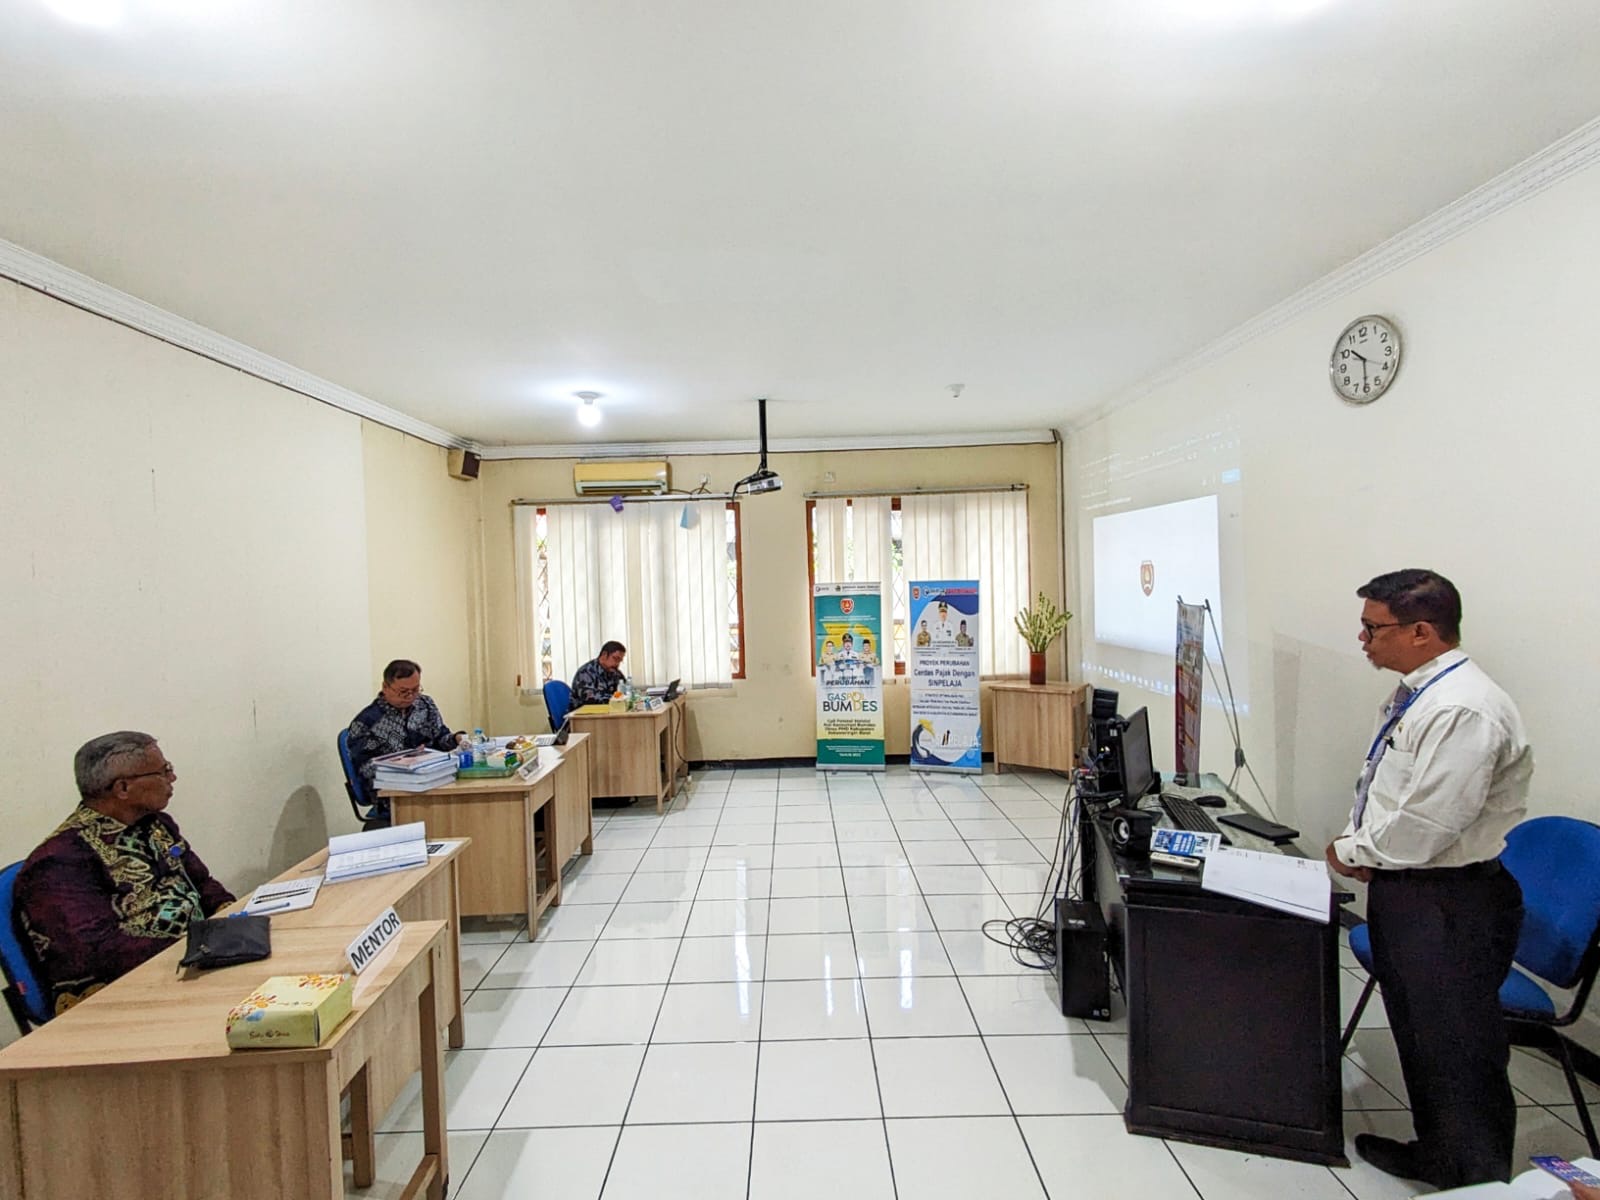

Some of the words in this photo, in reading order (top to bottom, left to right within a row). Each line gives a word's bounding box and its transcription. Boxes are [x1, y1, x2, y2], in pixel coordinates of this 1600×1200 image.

[1358, 326, 1368, 338] 12
[1349, 335, 1356, 344] 11
[1380, 332, 1388, 343] 2
[1340, 349, 1350, 359] 10
[1384, 346, 1392, 356] 3
[1340, 363, 1347, 373] 9
[1382, 361, 1389, 371] 4
[1344, 376, 1350, 385] 8
[1353, 383, 1360, 393] 7
[935, 669, 951, 678] Pajak
[952, 669, 976, 679] Dengan
[928, 679, 962, 687] SINPELAJA
[823, 700, 878, 712] BUMDES
[351, 912, 400, 969] MENTOR
